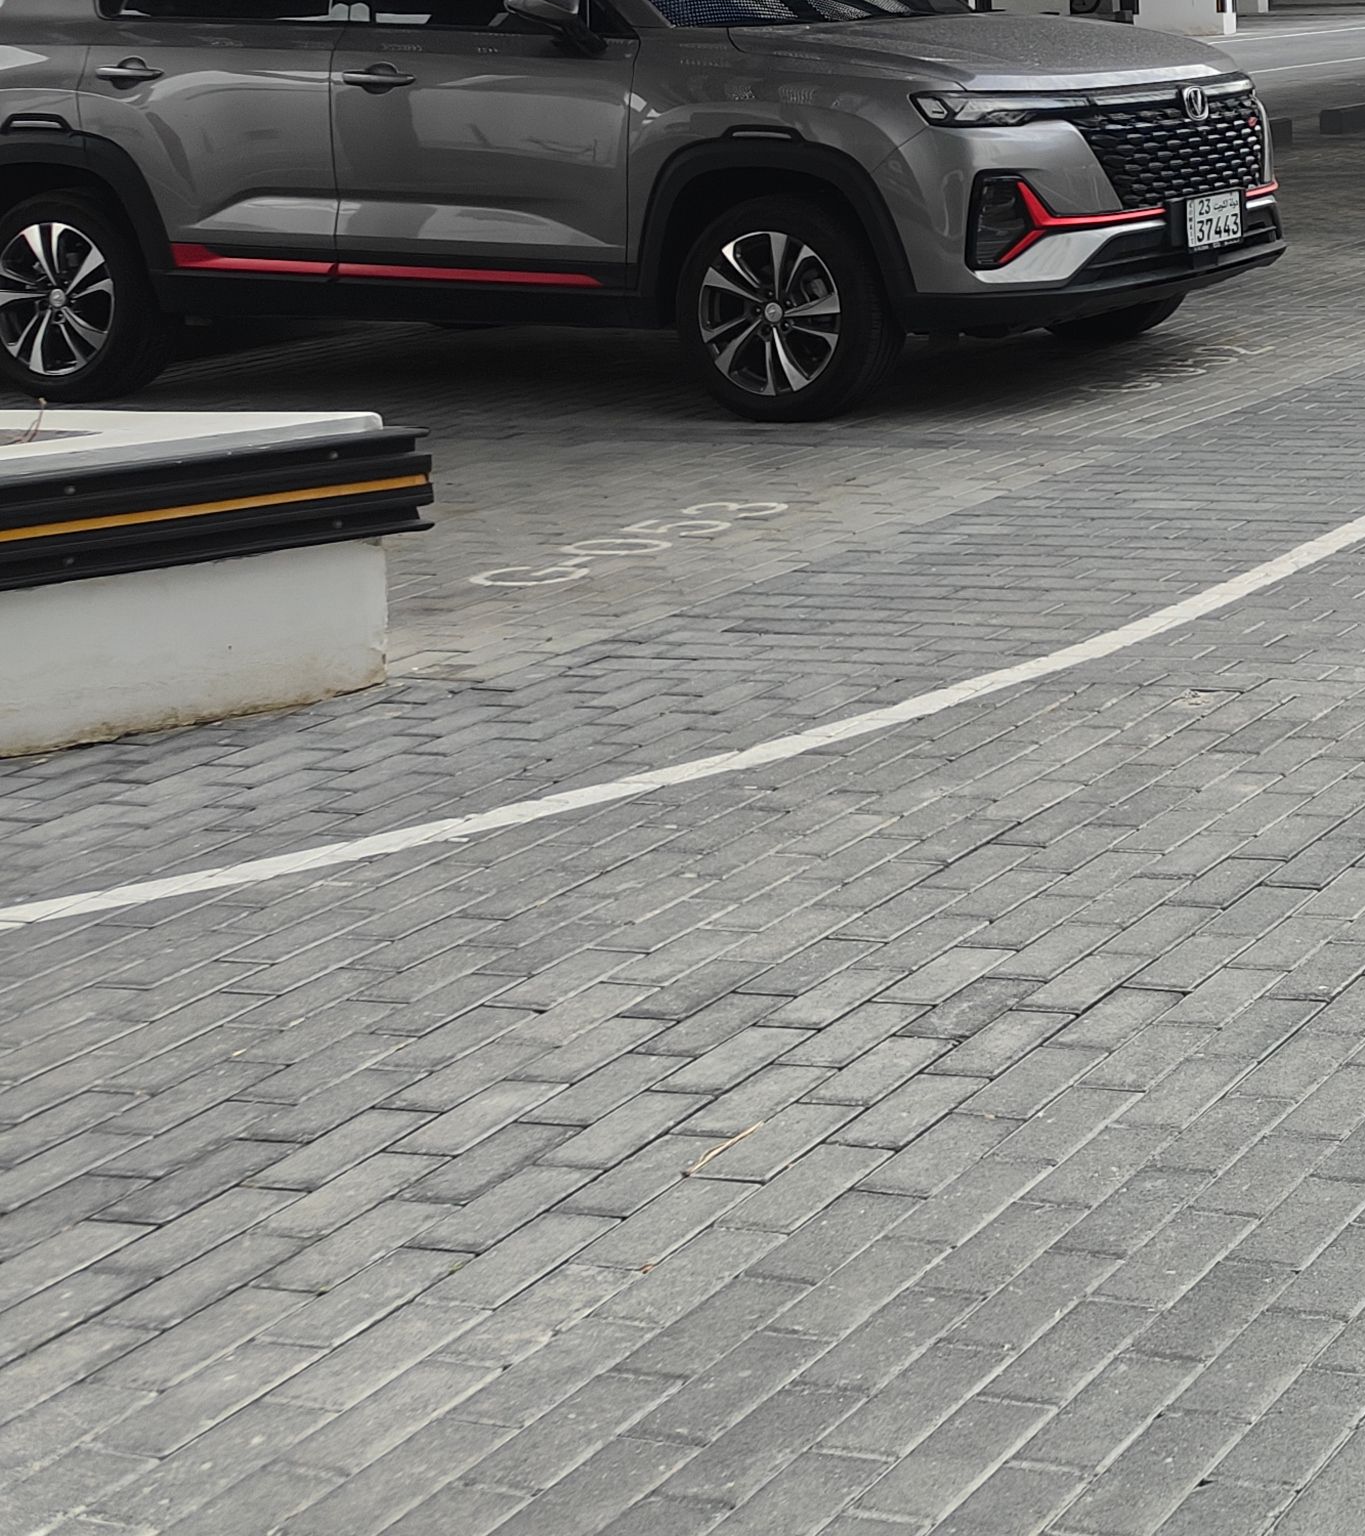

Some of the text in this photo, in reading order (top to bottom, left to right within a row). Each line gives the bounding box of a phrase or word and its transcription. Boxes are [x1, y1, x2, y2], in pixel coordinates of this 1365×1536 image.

[1198, 198, 1211, 216] 23
[1196, 212, 1239, 243] 37443
[468, 501, 789, 587] G-053
